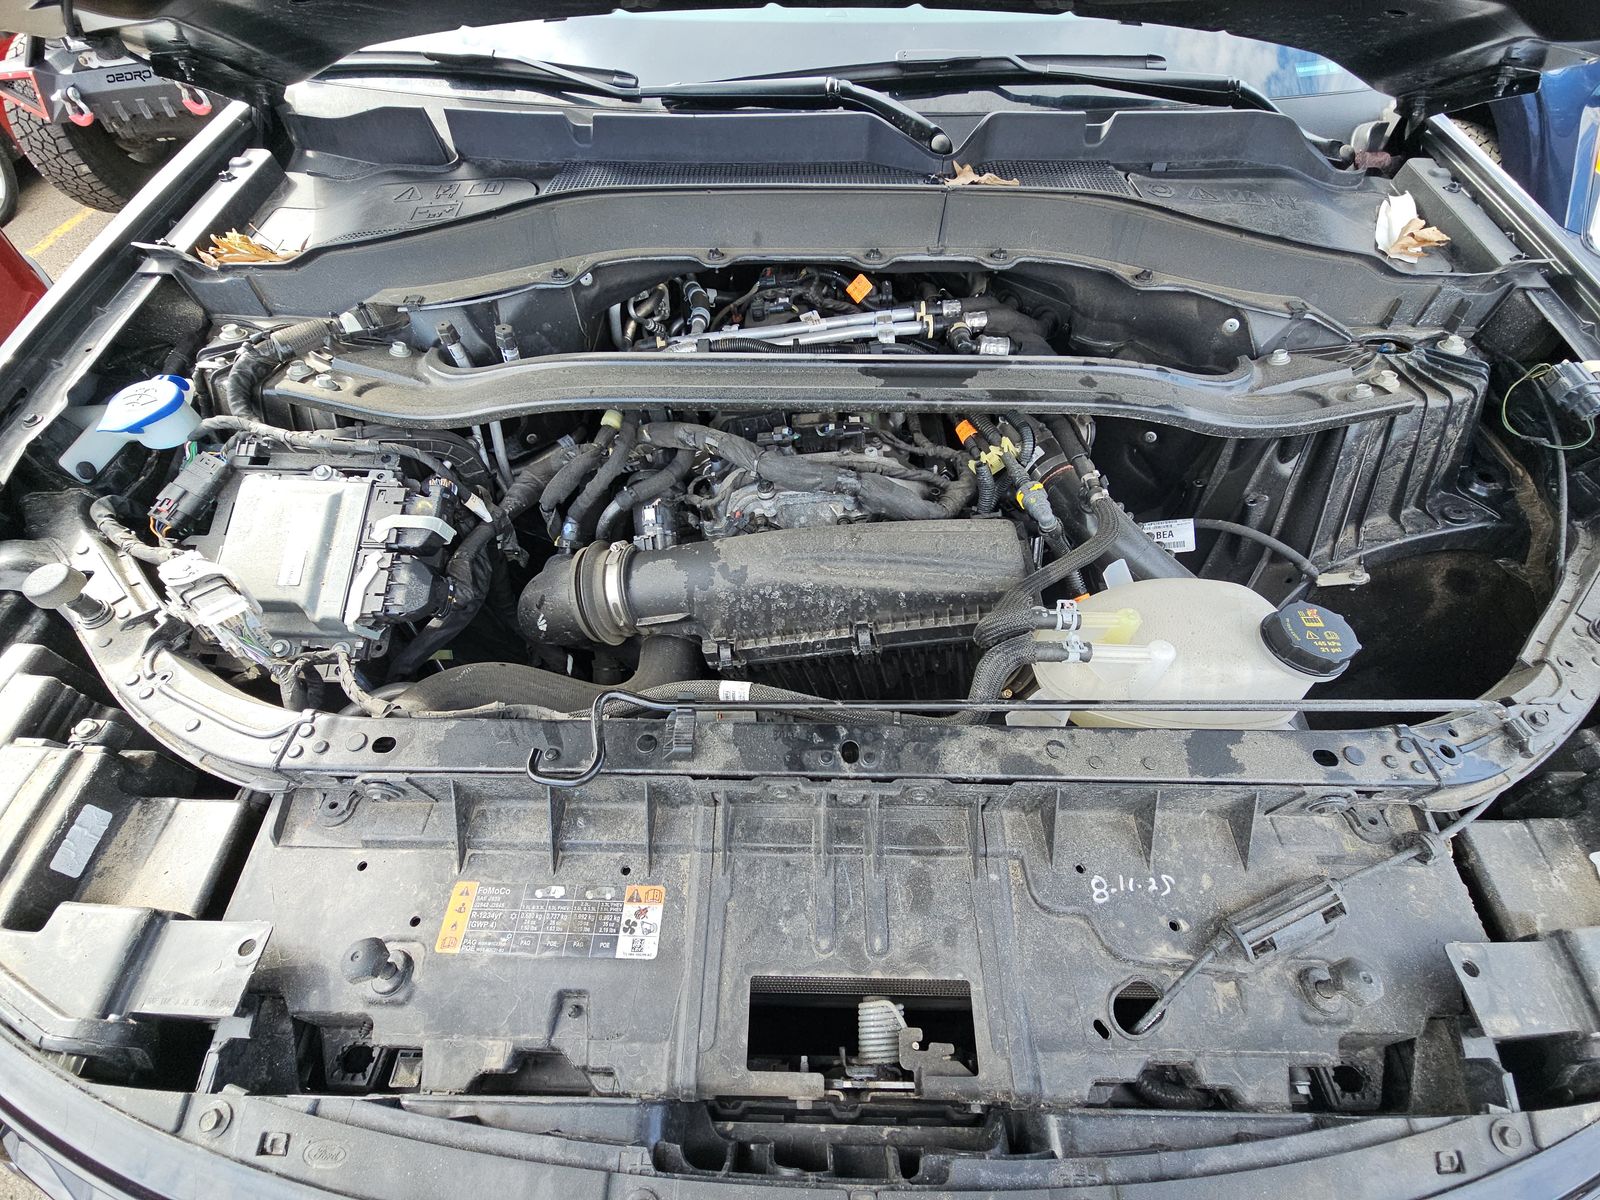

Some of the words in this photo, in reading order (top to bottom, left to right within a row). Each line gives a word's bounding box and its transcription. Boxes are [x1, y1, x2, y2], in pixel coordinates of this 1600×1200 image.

[1156, 530, 1174, 539] BEA
[477, 886, 511, 895] FoMoCo
[471, 911, 503, 920] R-1234yf
[468, 920, 489, 929] (GWP
[489, 921, 497, 930] 4)
[463, 938, 478, 946] PAG
